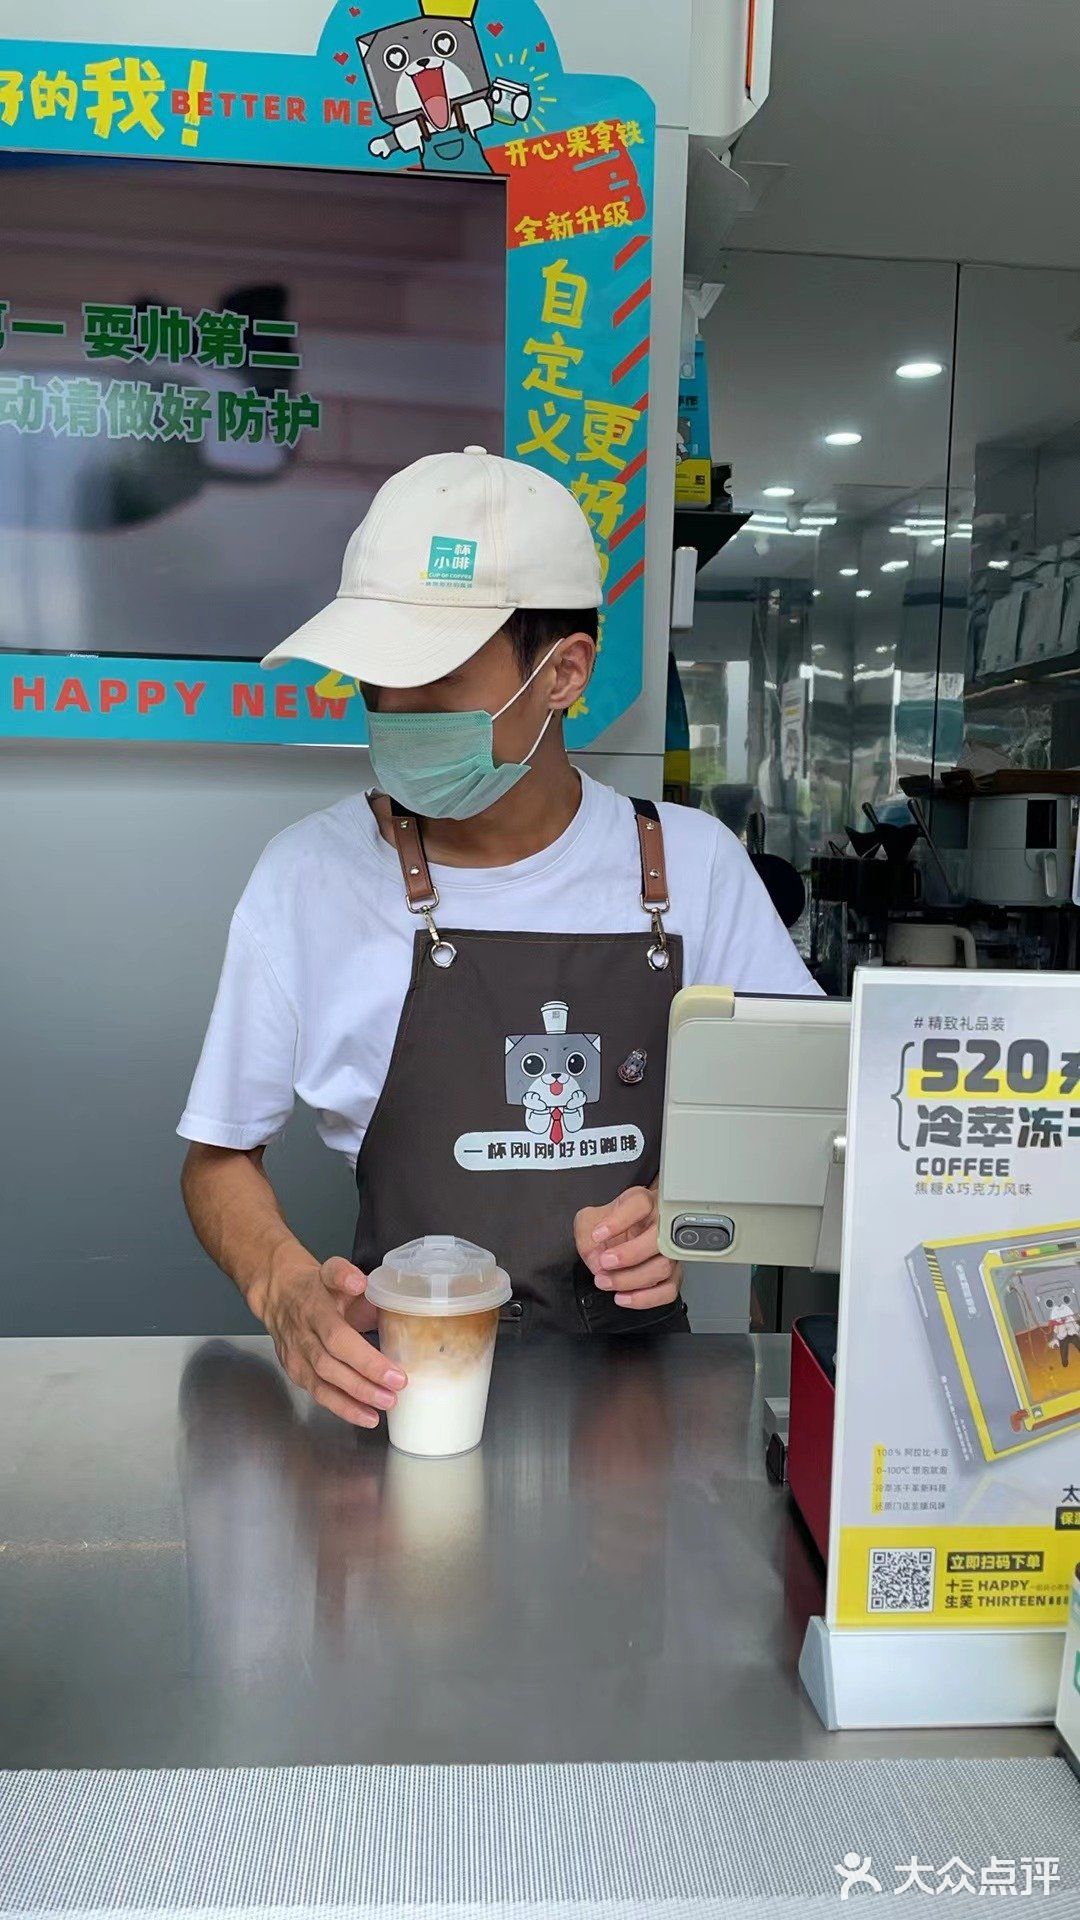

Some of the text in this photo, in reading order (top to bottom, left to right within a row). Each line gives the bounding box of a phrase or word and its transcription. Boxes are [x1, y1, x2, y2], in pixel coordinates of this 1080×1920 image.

[171, 90, 374, 126] BETTER ME
[505, 120, 645, 167] 开心果拿铁
[514, 201, 634, 247] 全新升级
[82, 302, 301, 369] 耍帅第二
[516, 258, 589, 464] 自定义
[436, 544, 471, 556] 一杯
[433, 556, 470, 570] 小啡
[12, 676, 207, 716] HAPPY
[231, 683, 349, 720] NEW
[463, 1134, 638, 1160] 一杯刚刚好的咖啡
[915, 1157, 1010, 1177] COFFEE
[914, 1182, 1032, 1197] 焦糖&巧克力风味
[949, 1554, 1041, 1570] 立即扫码下单
[945, 1578, 974, 1593] 十三
[978, 1579, 1030, 1591] HAPPY
[945, 1595, 974, 1609] 生笑
[977, 1595, 1046, 1607] THIRTEEN
